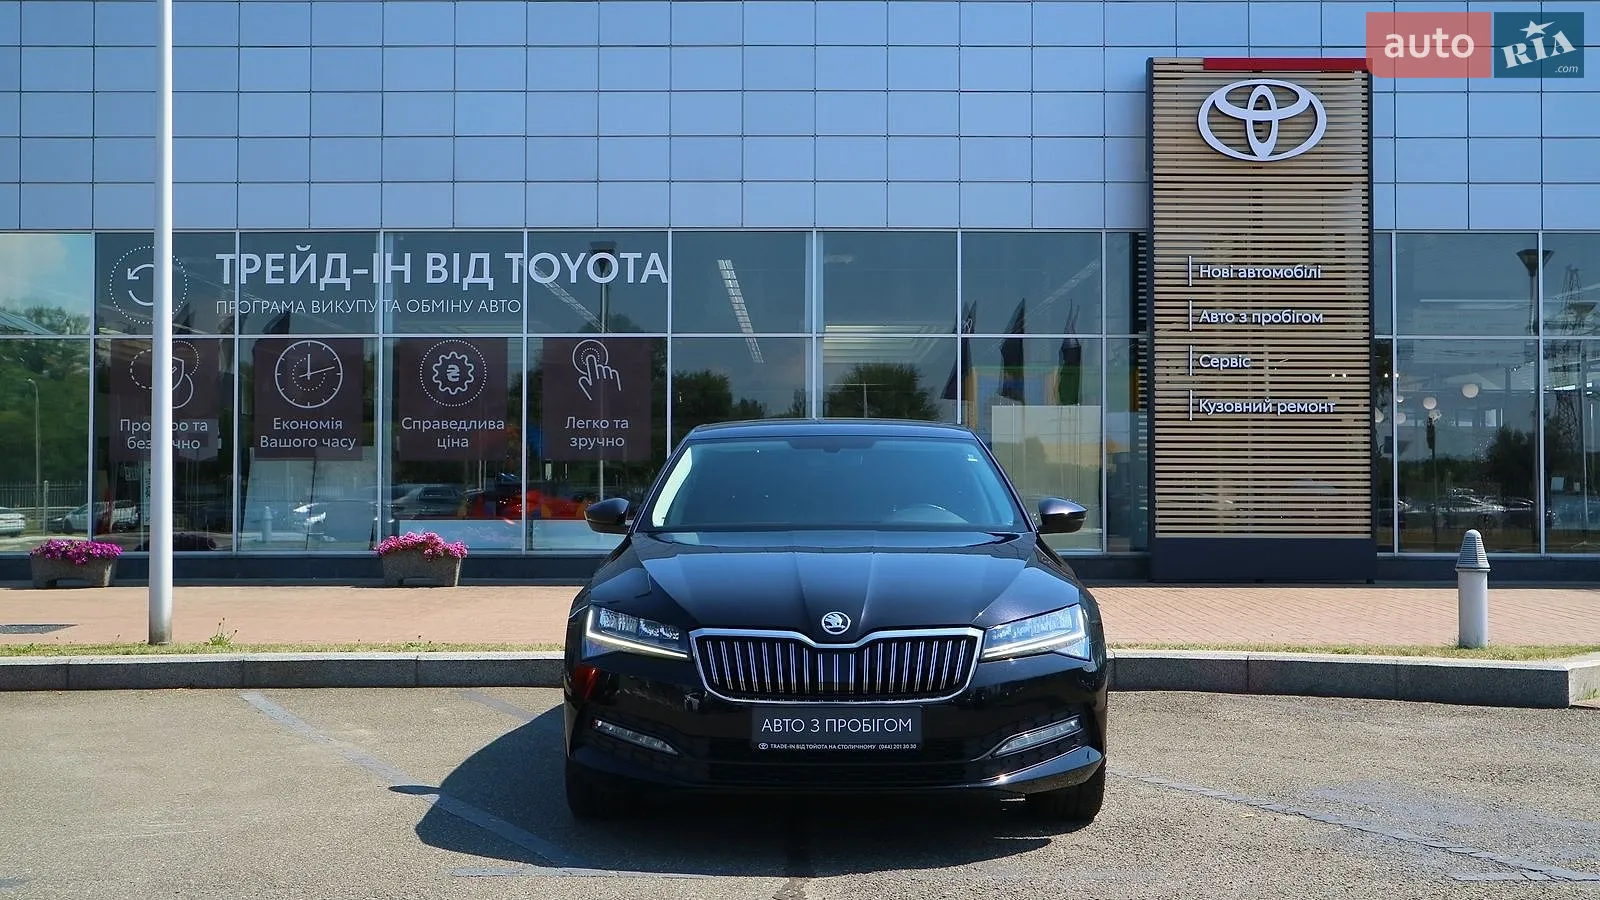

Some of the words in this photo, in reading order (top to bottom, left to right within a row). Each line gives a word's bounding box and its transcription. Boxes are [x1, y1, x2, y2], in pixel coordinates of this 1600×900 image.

[216, 245, 411, 291] ТРЕЙД-ІН
[426, 252, 494, 291] ВІД
[505, 252, 668, 284] TOYOTA
[1200, 265, 1233, 278] Нові
[1238, 265, 1321, 278] автомобілі
[216, 300, 305, 314] ПРОГРАМА
[311, 300, 378, 314] ВИКУПУ
[383, 299, 402, 313] ТА
[406, 299, 474, 313] ОБМІНУ
[478, 299, 521, 313] АВТО
[1200, 310, 1235, 323] Авто
[1239, 314, 1247, 323] з
[1252, 309, 1324, 326] пробігом
[1200, 354, 1251, 370] Сервіс
[1200, 398, 1273, 415] Кузовний
[1277, 402, 1336, 415] ремонт
[194, 422, 208, 431] та
[273, 417, 343, 430] Економія
[401, 417, 505, 433] Справедлива
[565, 417, 609, 429] Легко
[613, 419, 629, 429] та
[260, 436, 317, 448] Вашого
[321, 438, 357, 451] часу
[437, 435, 469, 449] ціна
[569, 436, 625, 450] зручно
[761, 718, 805, 732] АВТО
[825, 718, 912, 732] ПРОБІГОМ
